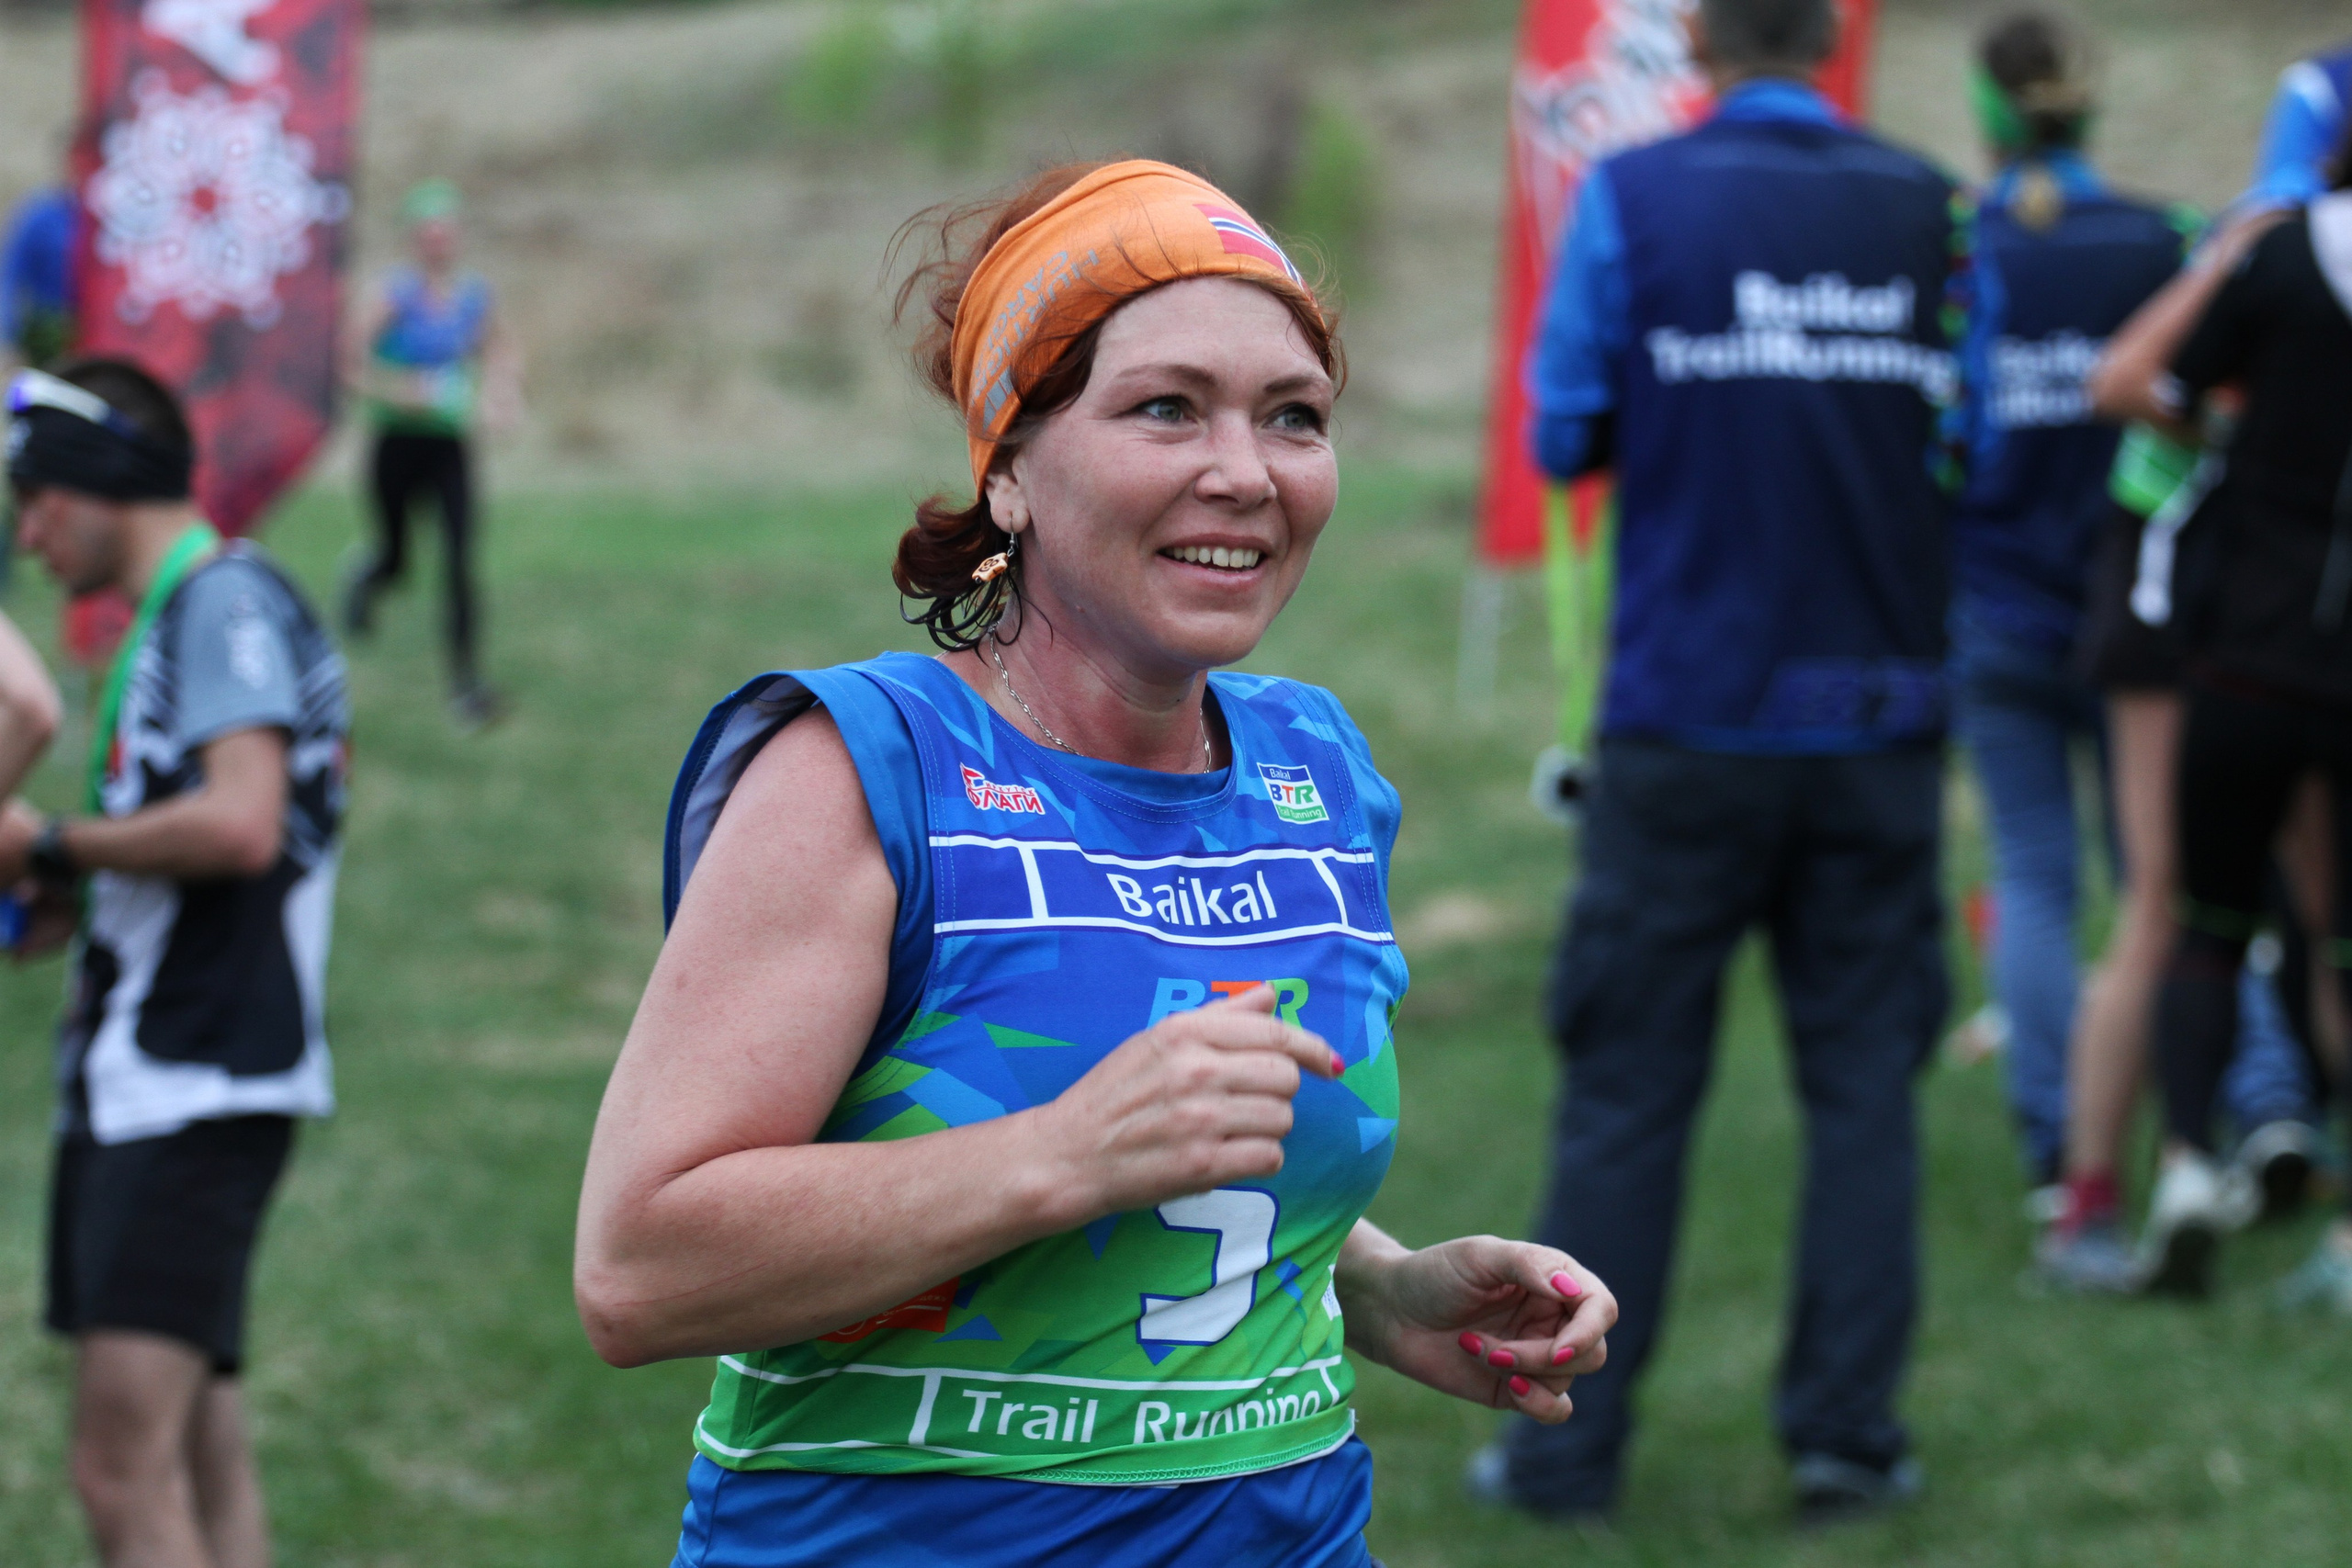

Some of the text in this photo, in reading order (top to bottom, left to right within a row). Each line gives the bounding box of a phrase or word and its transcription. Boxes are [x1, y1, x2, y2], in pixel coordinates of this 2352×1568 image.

[1269, 768, 1291, 781] Baikal
[967, 785, 1045, 814] ФЛАГИ
[1269, 784, 1315, 805] BTR
[1105, 870, 1278, 927] Baikal
[962, 1389, 1099, 1443] Trail
